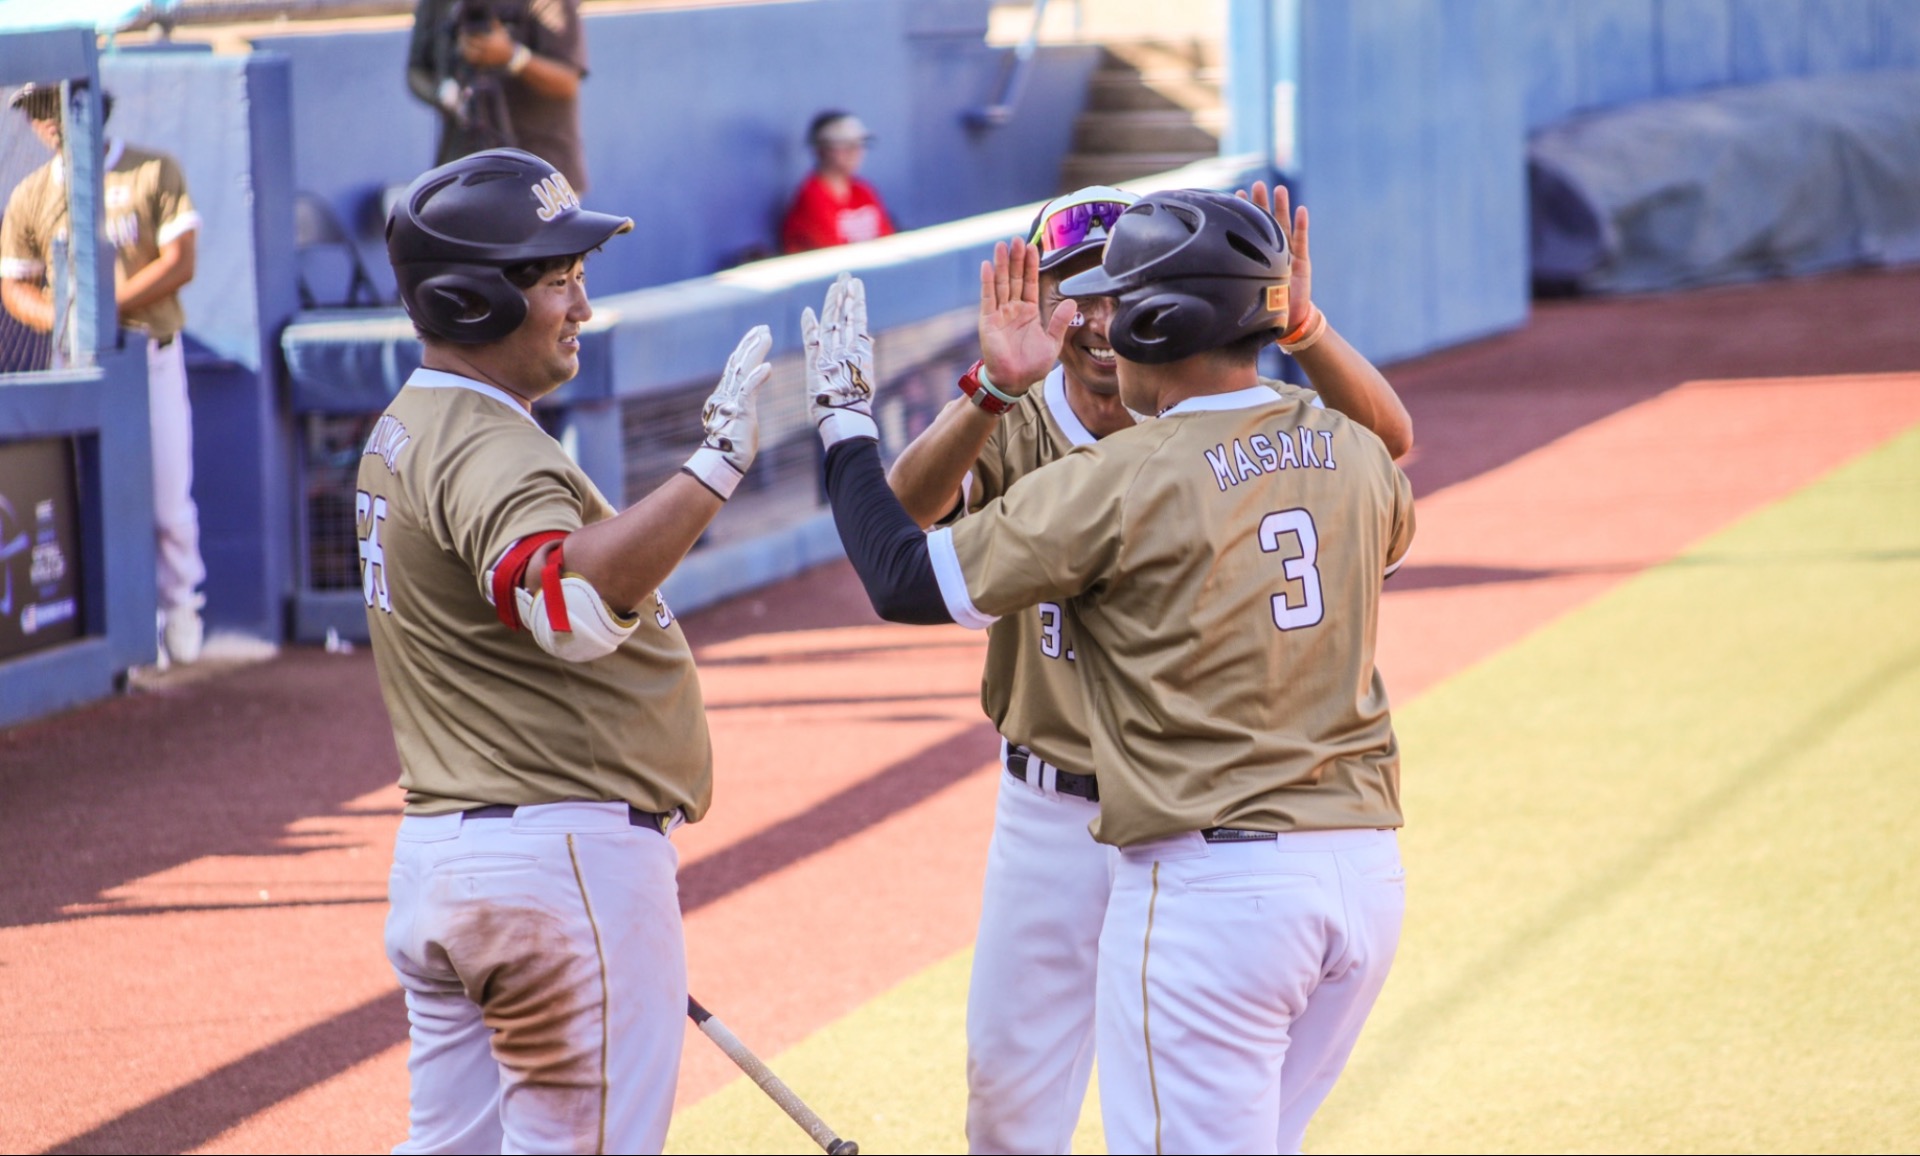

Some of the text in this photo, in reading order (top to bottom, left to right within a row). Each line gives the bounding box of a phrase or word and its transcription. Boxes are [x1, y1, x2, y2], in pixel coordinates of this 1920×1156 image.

[531, 172, 581, 222] JAP
[1204, 425, 1337, 492] MASAKI
[1257, 507, 1325, 632] 3
[1037, 601, 1076, 662] 3
